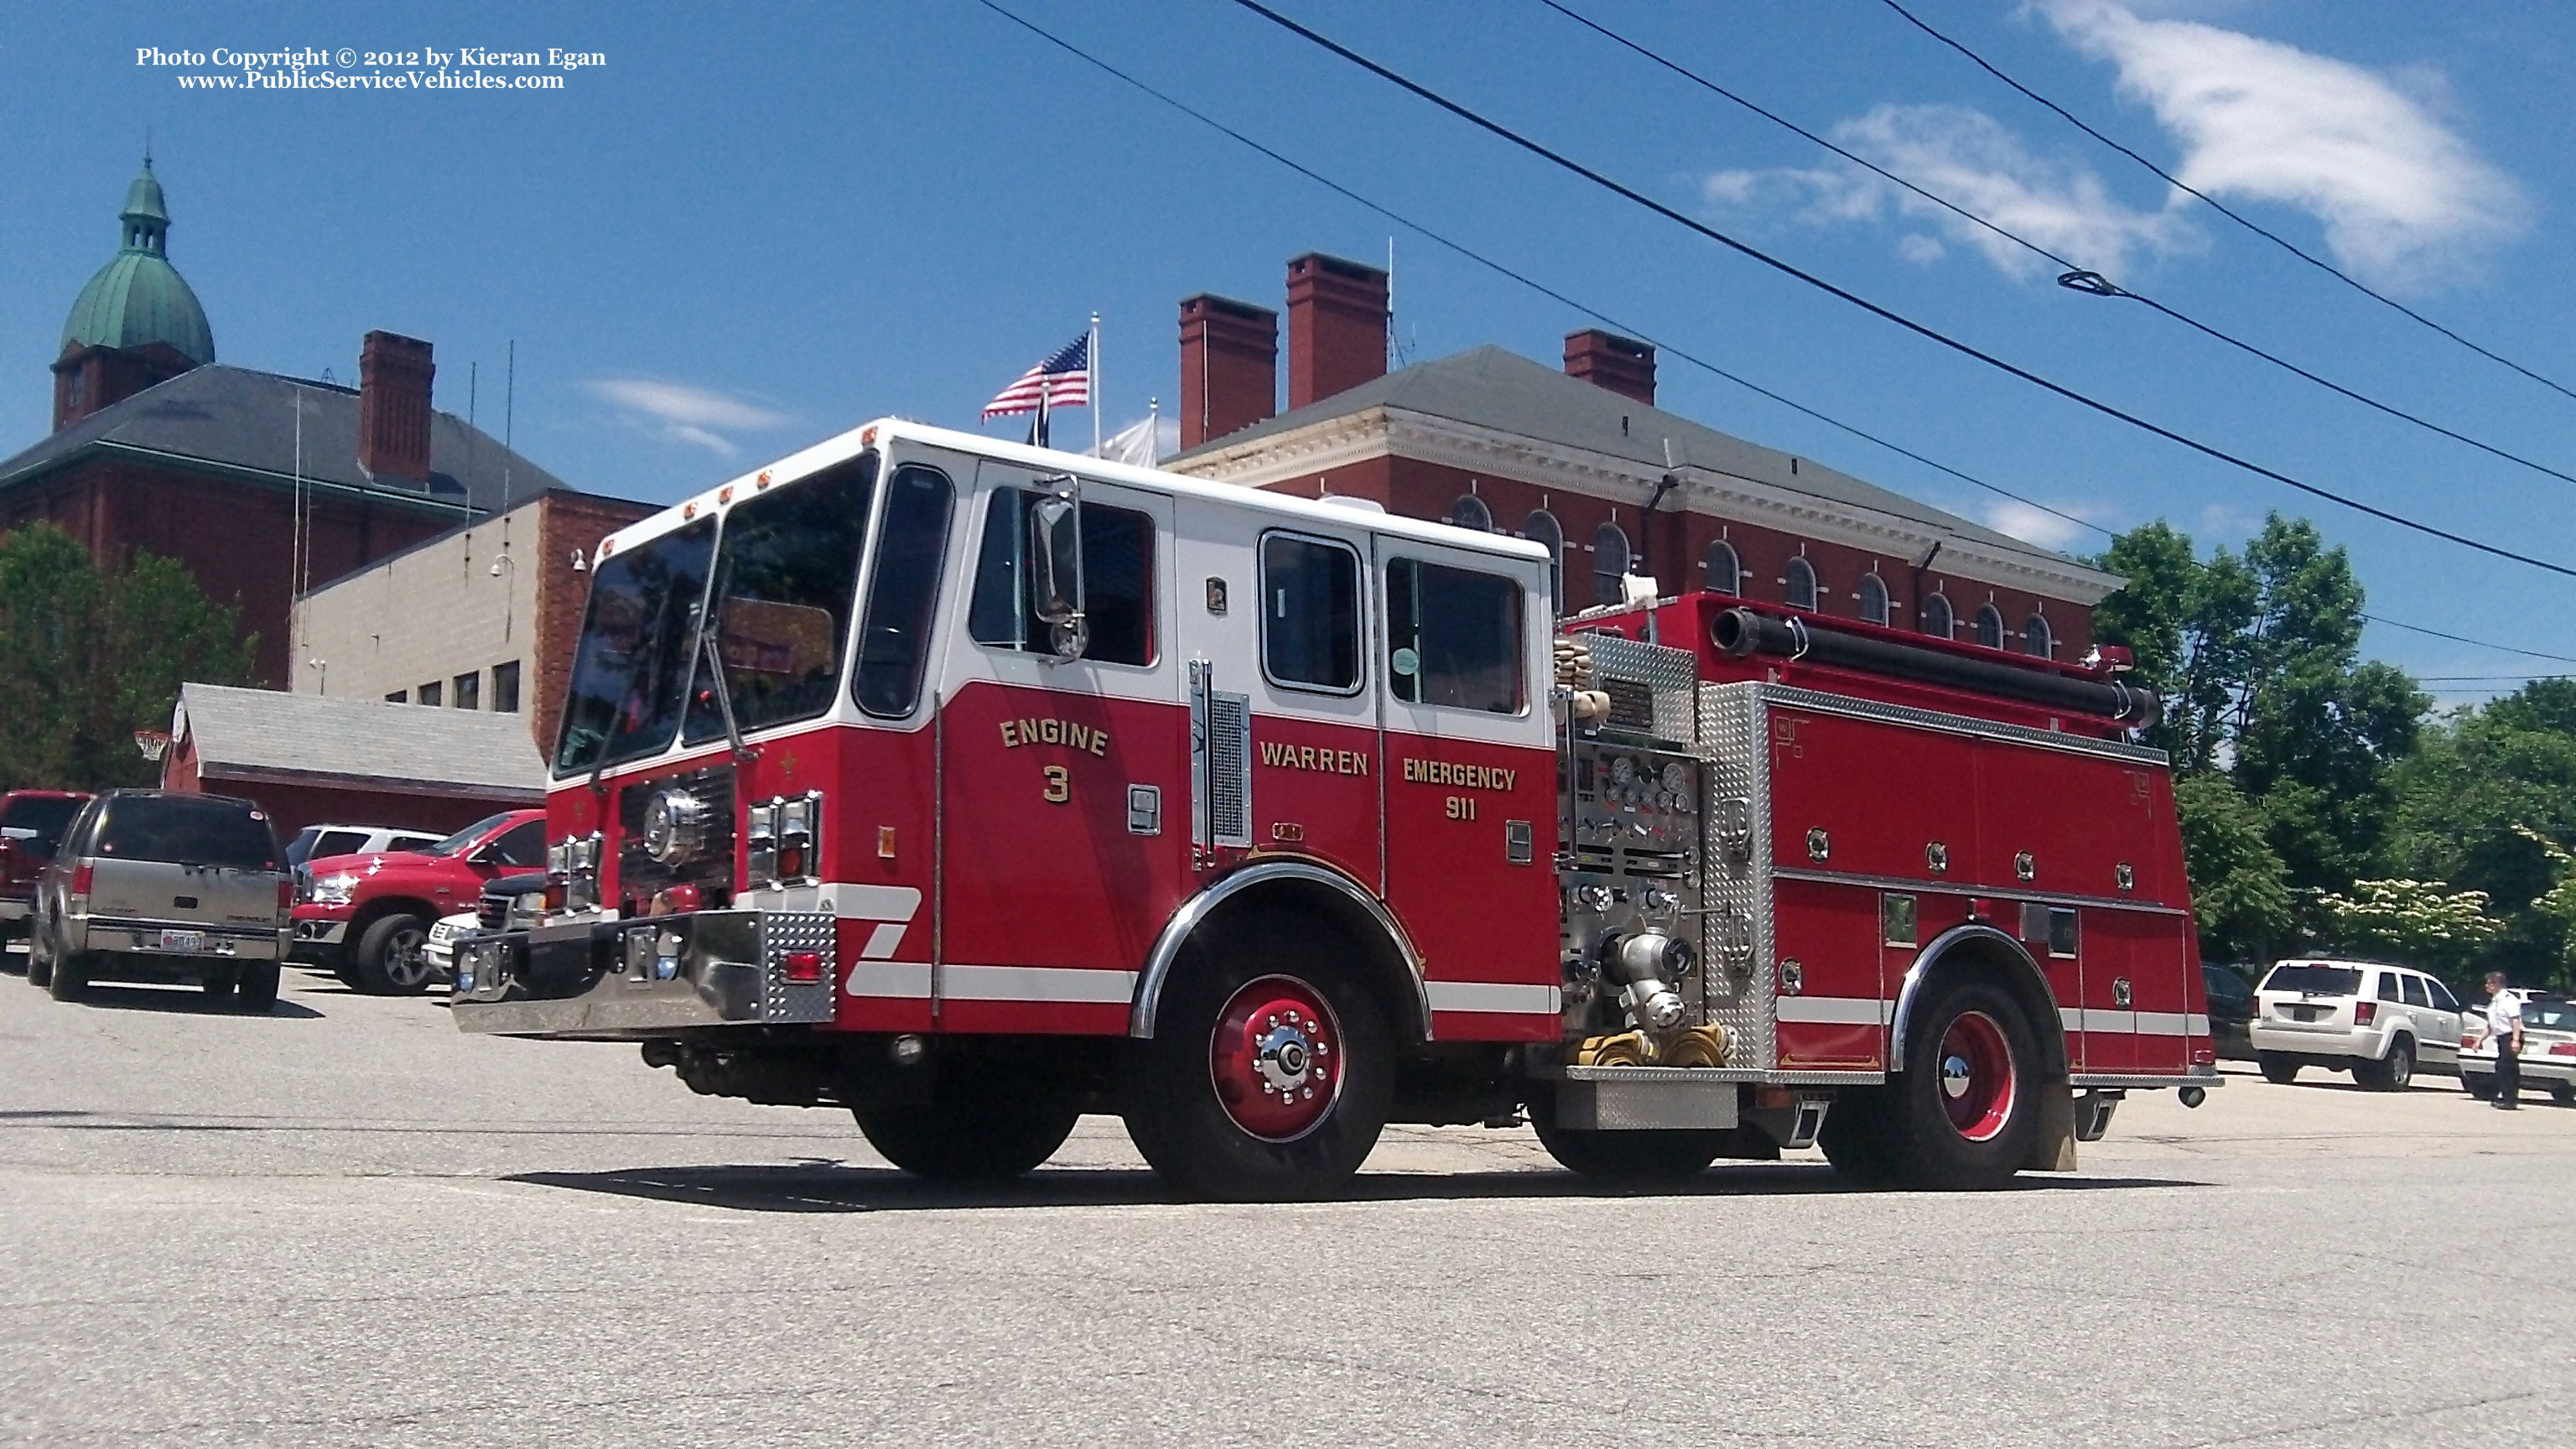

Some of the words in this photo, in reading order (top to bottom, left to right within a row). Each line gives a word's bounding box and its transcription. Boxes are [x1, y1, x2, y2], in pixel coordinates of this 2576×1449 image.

[1000, 718, 1109, 756] ENGINE
[1259, 741, 1368, 776] WARREN
[1404, 757, 1516, 791] EMERGENCY
[1043, 765, 1068, 802] 3
[1445, 796, 1476, 820] 911
